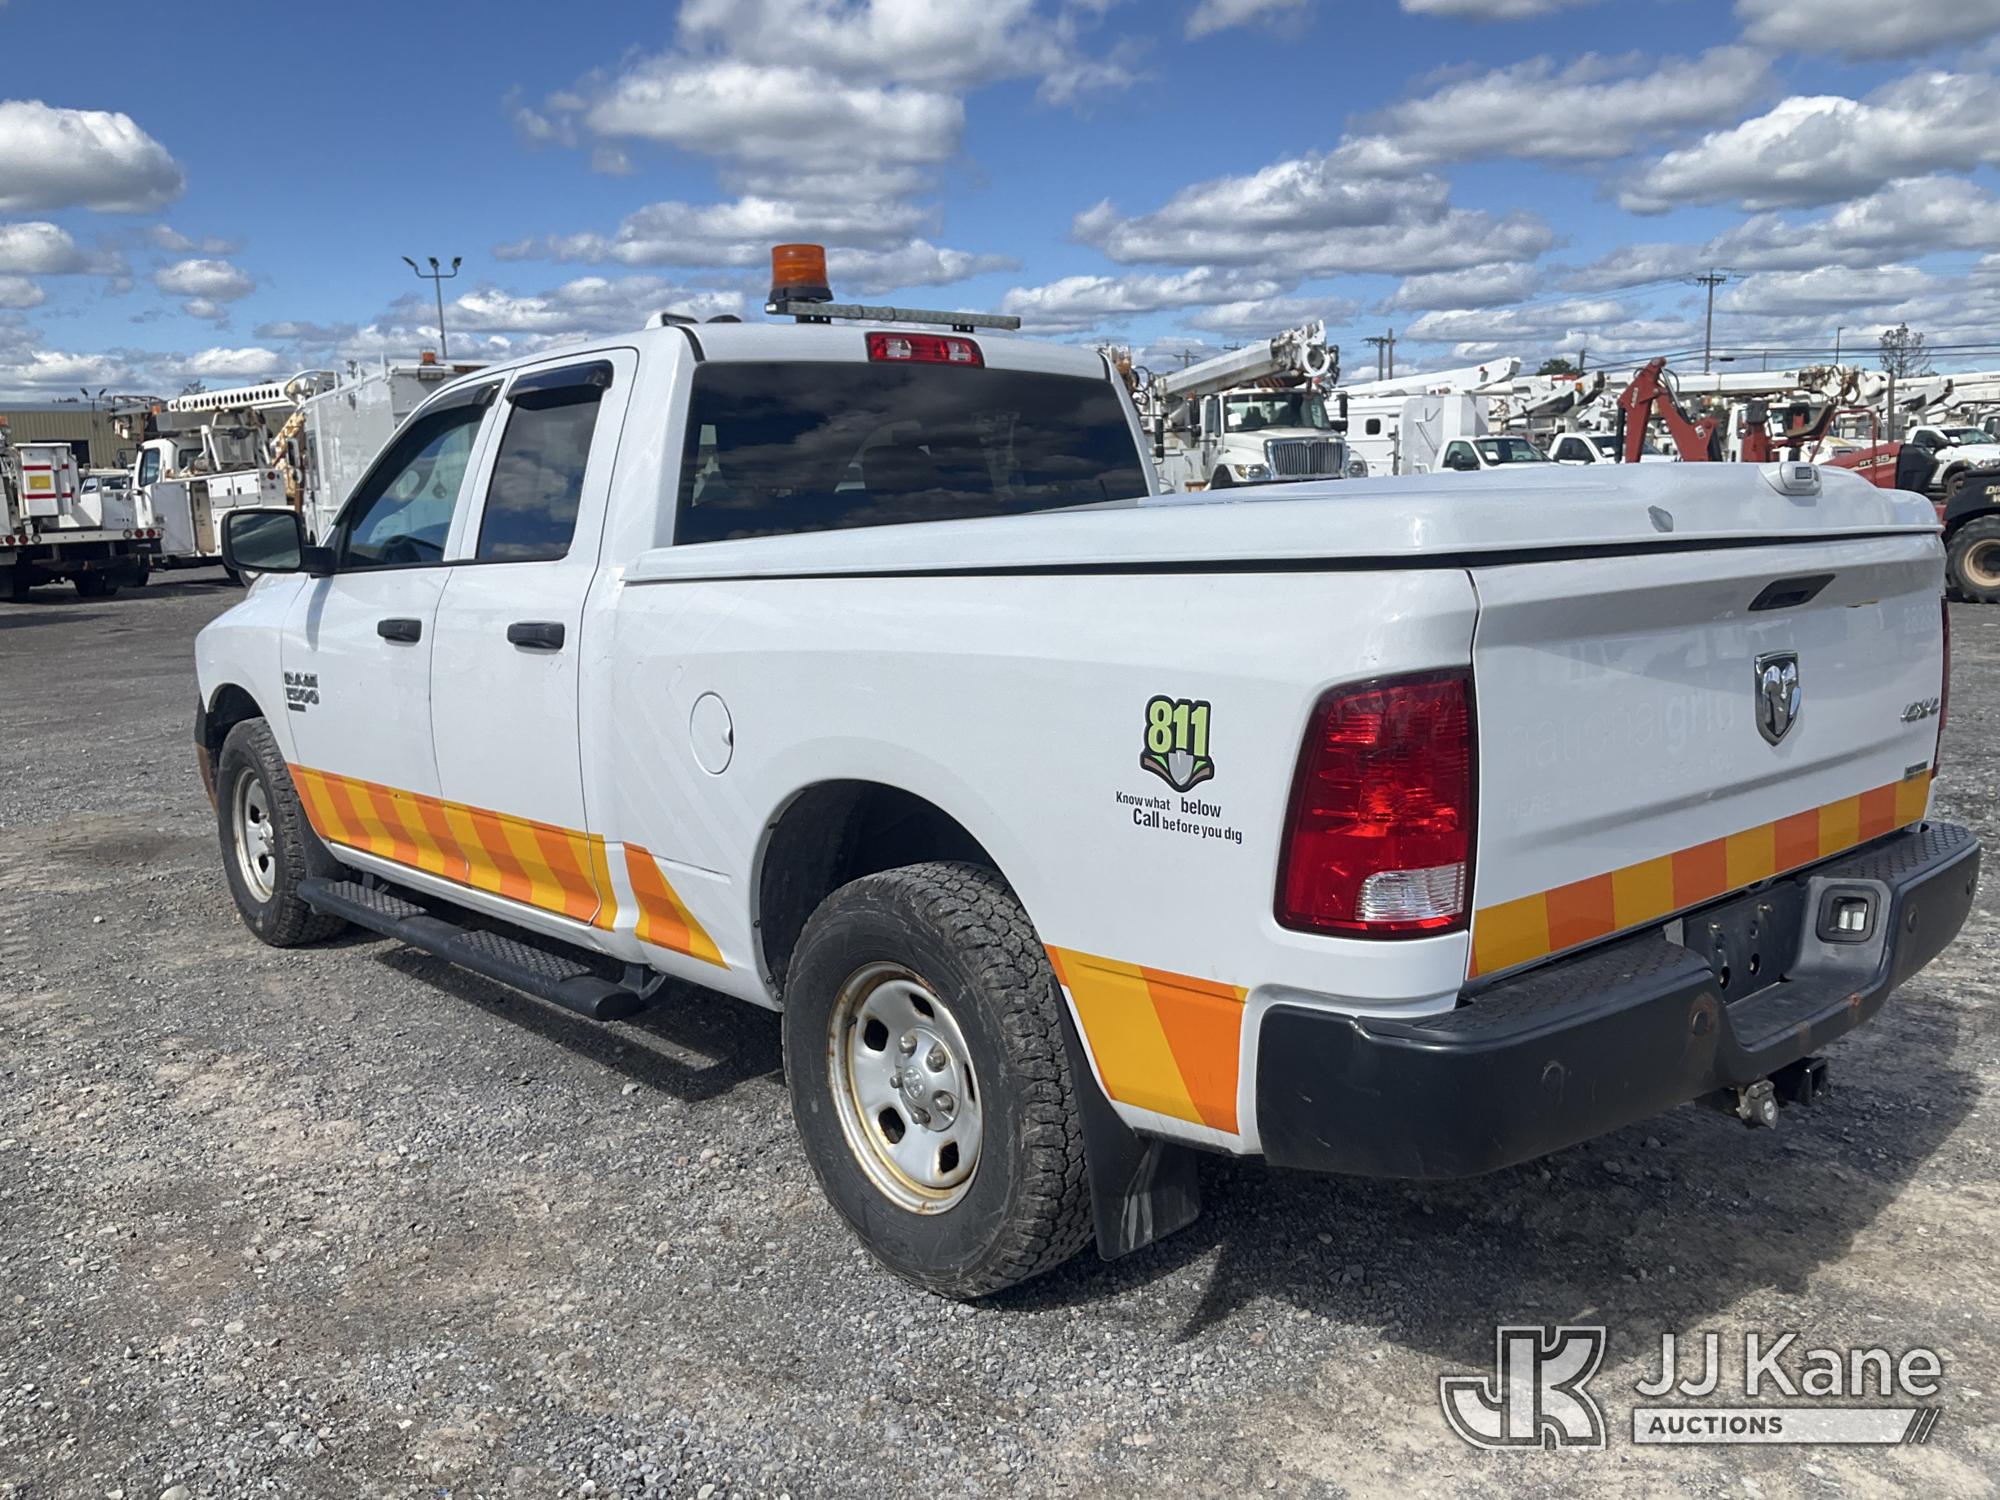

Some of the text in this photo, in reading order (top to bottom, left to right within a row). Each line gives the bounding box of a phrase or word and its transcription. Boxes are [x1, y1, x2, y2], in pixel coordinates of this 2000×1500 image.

[284, 671, 318, 689] RAM
[286, 687, 320, 705] 1500
[1147, 698, 1209, 757] 811
[1116, 791, 1222, 818] Know what below
[1133, 808, 1243, 845] Call before you dig
